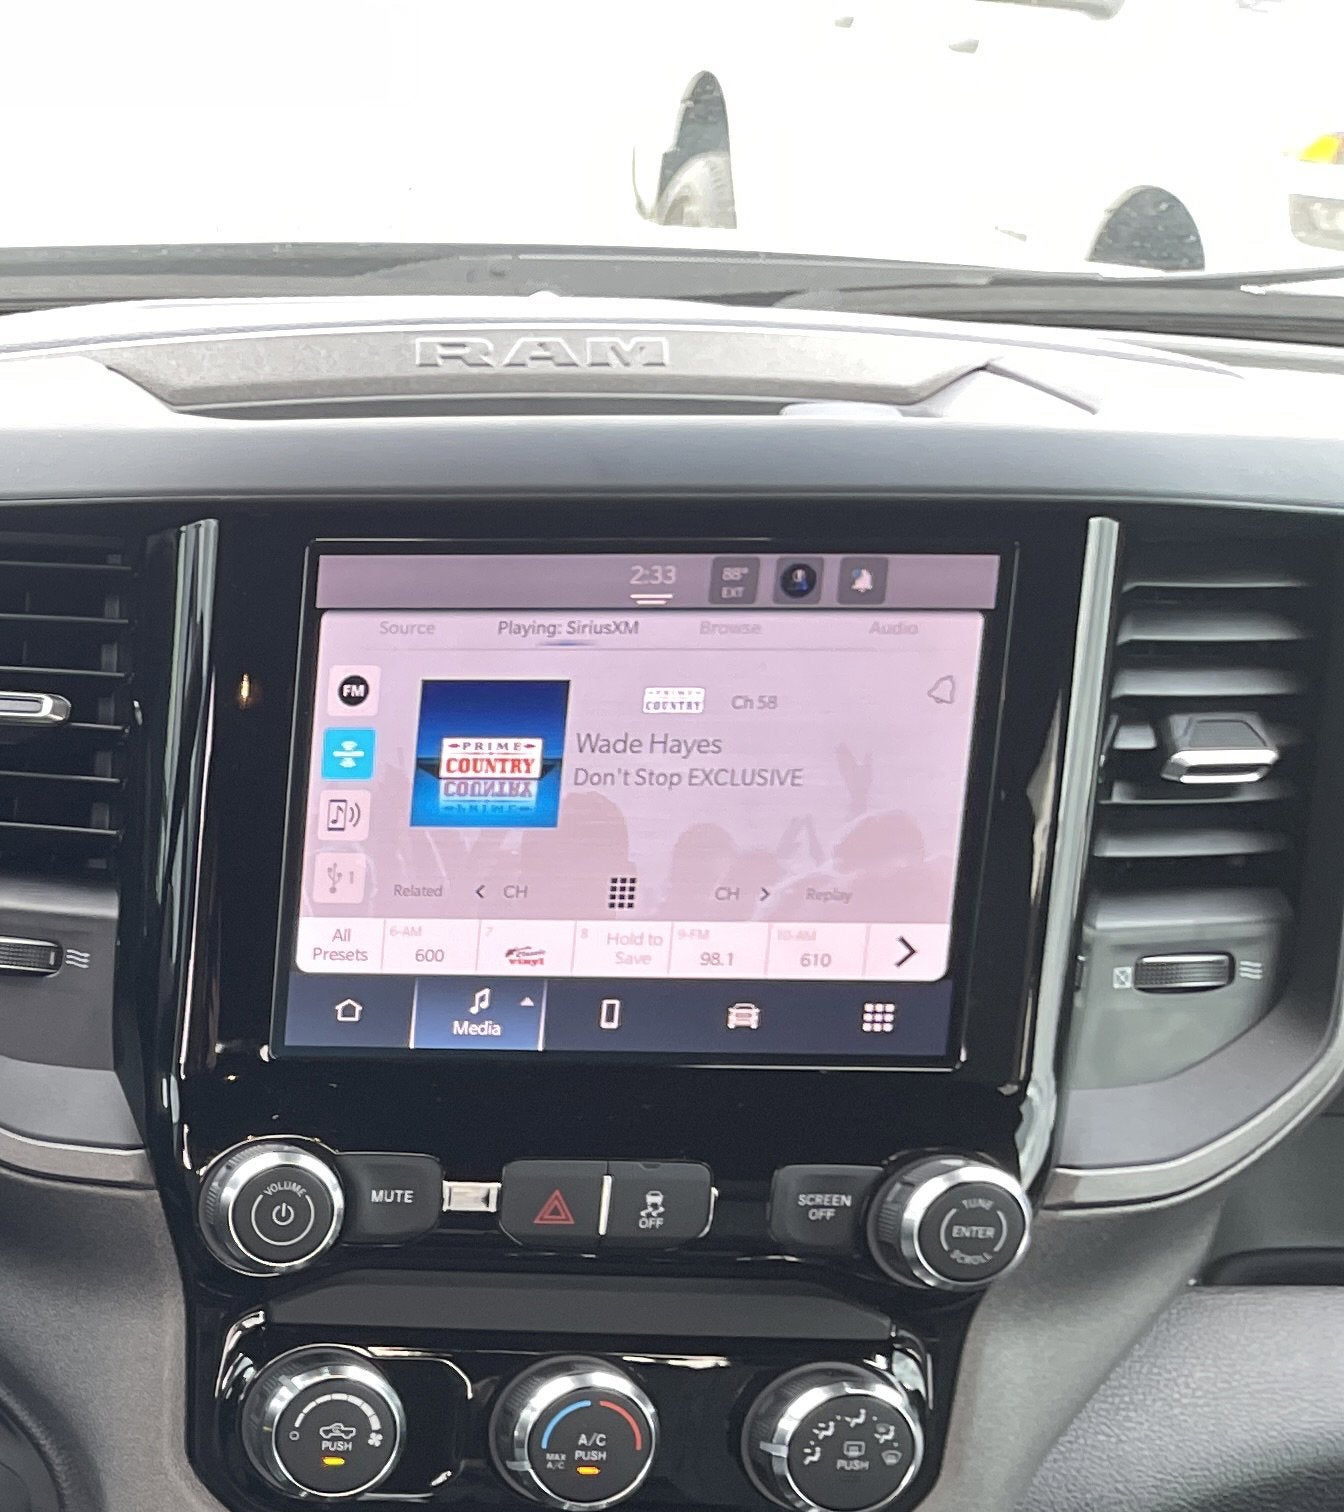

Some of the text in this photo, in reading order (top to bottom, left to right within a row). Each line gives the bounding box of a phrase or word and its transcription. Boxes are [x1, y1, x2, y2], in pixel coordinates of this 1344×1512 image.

[415, 336, 669, 367] RAM
[630, 565, 677, 585] 2:33
[721, 587, 744, 599] EXT
[380, 621, 436, 635] Source
[498, 621, 639, 638] Playing: SiriusXM
[700, 621, 762, 635] Browse
[869, 621, 919, 635] Audio
[343, 685, 365, 698] FM
[732, 695, 778, 710] Ch 58
[463, 741, 522, 751] PRIME
[576, 732, 723, 758] Wade Hayes
[446, 758, 535, 774] COUNTRY
[574, 767, 804, 789] Don't Stop EXCLUSIVE
[393, 884, 443, 898] Related
[503, 885, 528, 899] CH
[715, 887, 740, 901] CH
[806, 888, 853, 903] Replay
[332, 929, 351, 942] All
[607, 932, 663, 946] Hold to
[312, 948, 368, 962] Presets
[415, 949, 445, 962] 600
[615, 952, 652, 965] Save
[700, 952, 734, 967] 98.1
[800, 953, 832, 967] 610
[453, 1020, 501, 1036] Media
[263, 1181, 307, 1198] VOLUME
[370, 1189, 414, 1204] MUTE
[797, 1193, 852, 1207] SCREEN
[962, 1198, 995, 1211] TUNE
[808, 1208, 836, 1221] OFF
[638, 1217, 664, 1229] OFF
[952, 1226, 996, 1239] ENTER
[322, 1440, 353, 1451] PUSH
[578, 1433, 607, 1447] A/C
[546, 1453, 567, 1461] MAX
[574, 1450, 607, 1461] PUSH
[836, 1459, 870, 1471] PUSH
